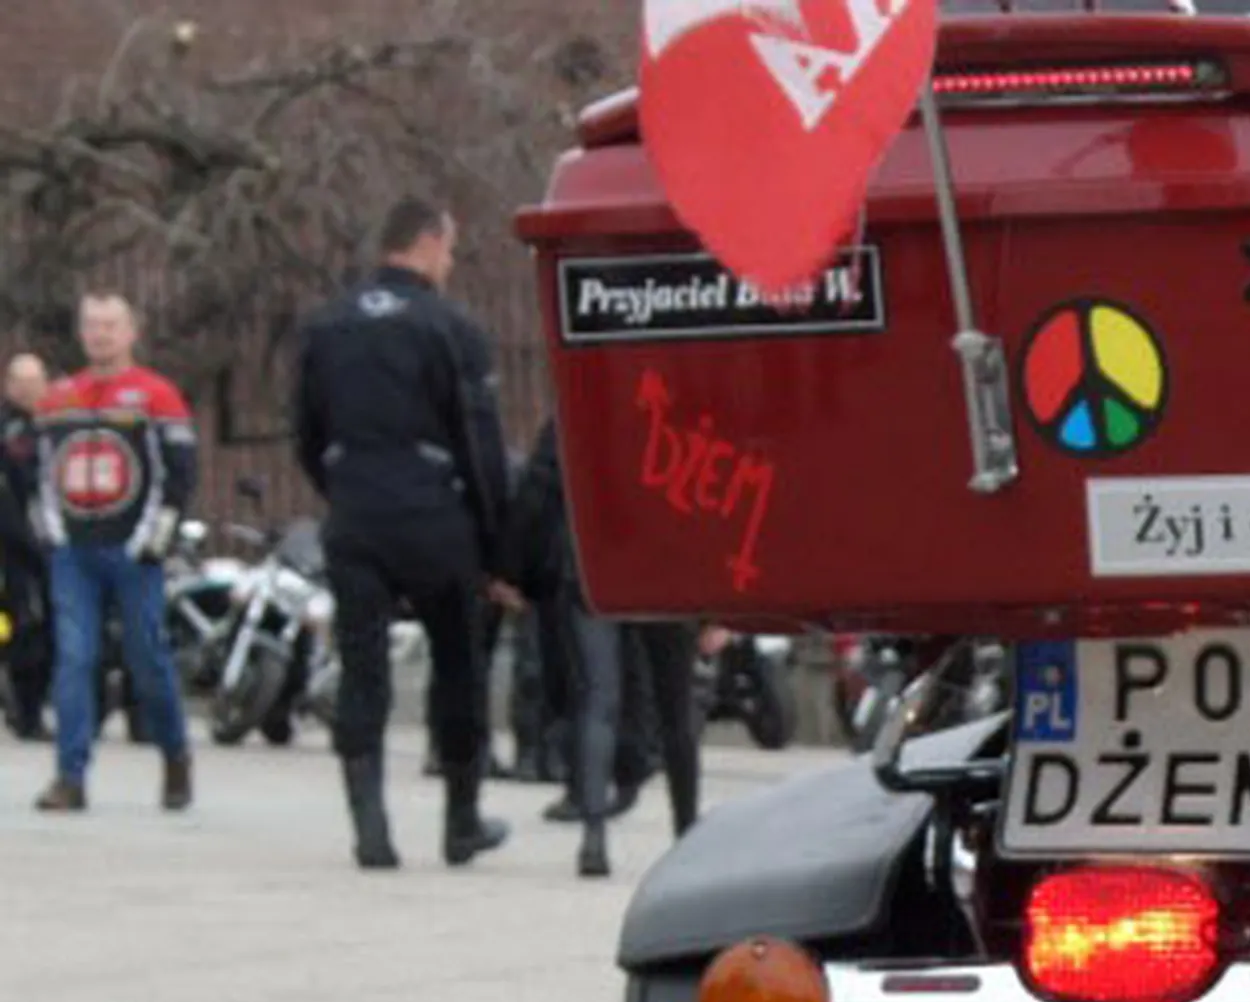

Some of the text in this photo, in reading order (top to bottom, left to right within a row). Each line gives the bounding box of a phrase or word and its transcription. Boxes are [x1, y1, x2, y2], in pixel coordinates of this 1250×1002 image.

[578, 274, 728, 324] Przyjaciel
[1133, 494, 1204, 555] Żyj
[1220, 503, 1233, 541] i
[1021, 693, 1072, 731] PL
